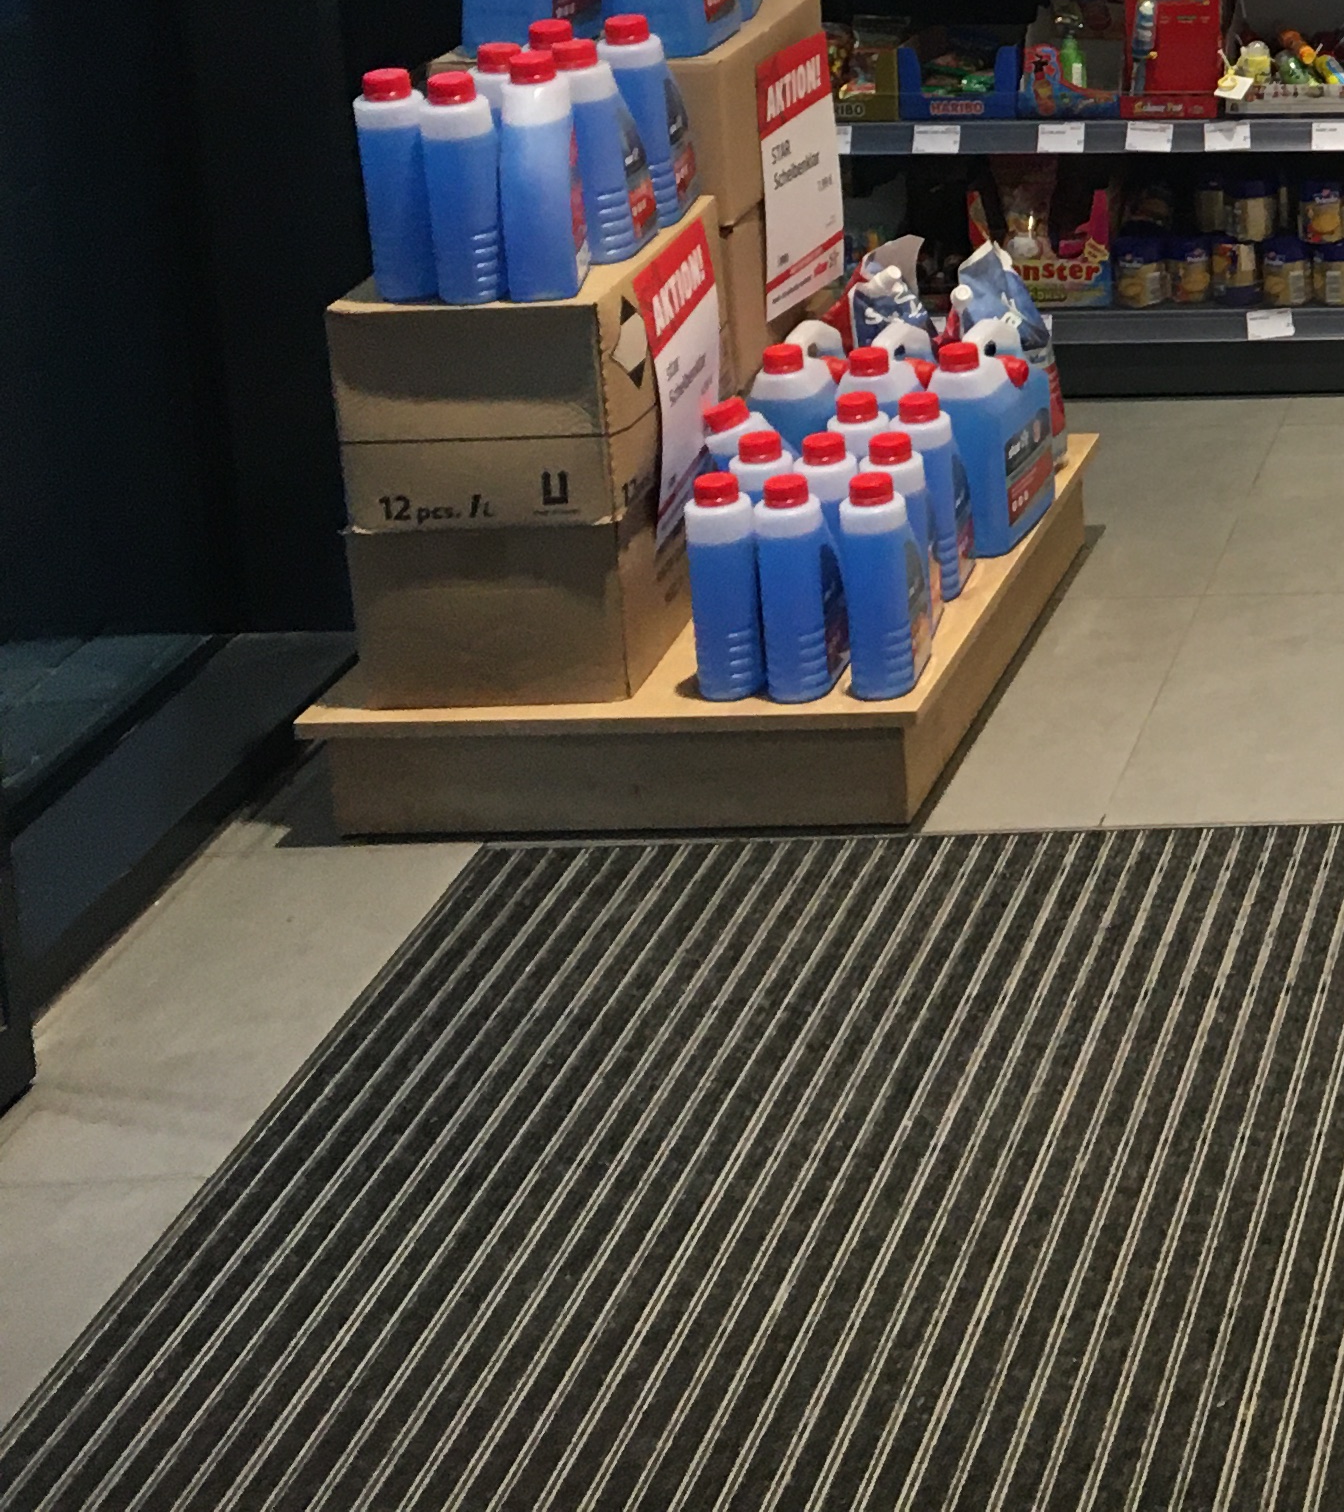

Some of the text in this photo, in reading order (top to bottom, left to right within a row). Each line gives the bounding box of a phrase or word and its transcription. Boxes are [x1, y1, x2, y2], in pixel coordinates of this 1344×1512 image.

[766, 54, 822, 123] AKTION!
[929, 100, 985, 116] HARIBO
[1012, 261, 1100, 282] onster
[652, 245, 706, 336] AKTION!
[379, 494, 462, 524] 12 pcs.
